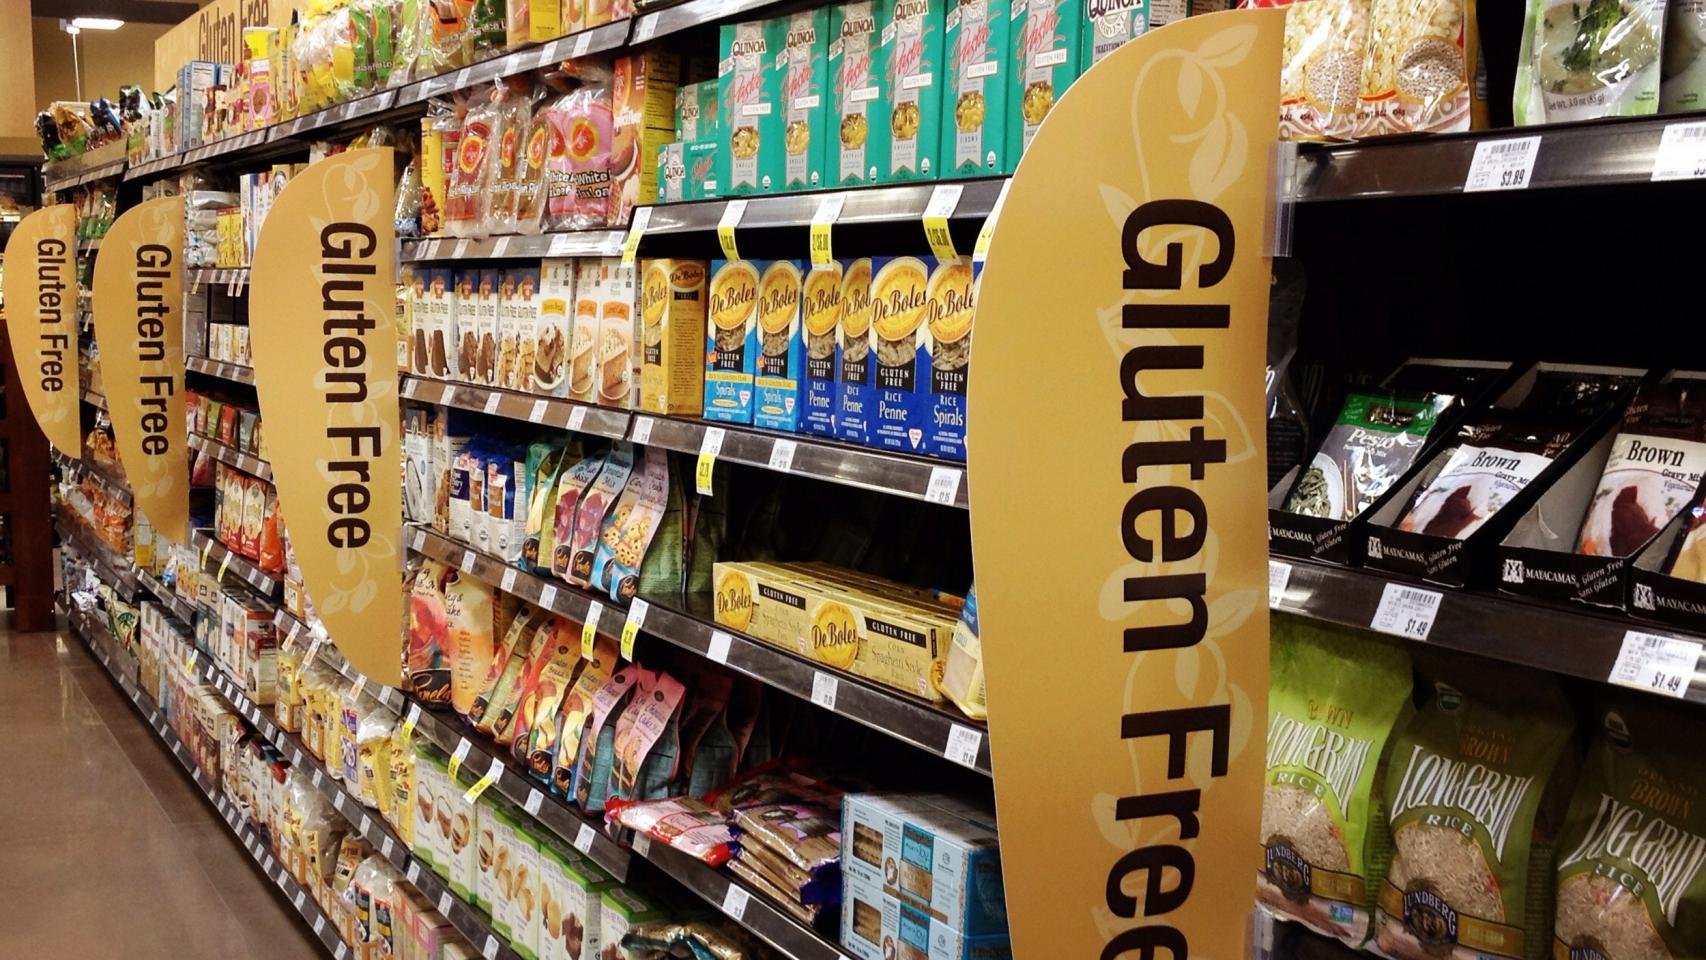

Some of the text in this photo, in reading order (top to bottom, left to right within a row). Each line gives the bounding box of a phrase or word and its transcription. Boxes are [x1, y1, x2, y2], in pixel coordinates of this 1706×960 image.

[896, 1, 928, 20] QUINOA
[199, 6, 235, 64] Gluten
[843, 19, 874, 36] QUINOA
[788, 30, 815, 48] QUINOA
[733, 41, 765, 56] QUINOA
[1500, 168, 1525, 187] $3.89
[37, 239, 68, 392] Gluten Free
[136, 244, 174, 456] Gluten Free
[718, 353, 740, 361] GLUTEN
[764, 358, 785, 366] GLUTEN
[767, 366, 780, 374] FREE
[809, 361, 831, 369] GLUTEN
[844, 363, 864, 373] GLUTEN
[812, 368, 826, 377] FREE
[847, 372, 860, 381] FREE
[880, 368, 909, 379] GLUTEN
[935, 371, 964, 381] GLUTEN
[320, 222, 381, 549] Gluten Free
[812, 381, 826, 390] RICE
[885, 377, 903, 387] FREE
[940, 381, 957, 391] FREE
[808, 390, 830, 408] Penne
[843, 394, 863, 414] Penne
[885, 391, 902, 402] RICE
[939, 395, 957, 406] RICE
[879, 401, 908, 421] Penne
[933, 404, 964, 427] Spirals
[1347, 428, 1395, 448] Pesto
[1471, 451, 1521, 471] Brown
[1626, 440, 1685, 467] Brown
[1661, 468, 1687, 481] Gravy
[1272, 527, 1313, 543] MAYACAMAS
[1383, 546, 1426, 563] MAYACAMAS
[1099, 198, 1235, 960] Gluten Free
[1525, 568, 1577, 584] MAYACAMAS
[1581, 559, 1624, 585] Gluten Free
[1593, 574, 1618, 593] Gluten
[763, 587, 799, 606] GLUTEN FREE
[1656, 596, 1706, 615] MAYACAM
[872, 621, 916, 643] GLUTEN FREE
[1405, 618, 1428, 636] $1.49
[1652, 671, 1682, 692] $1.49
[1277, 772, 1324, 795] RICE
[1426, 813, 1473, 836] RICE
[1267, 845, 1310, 886] LUNDBERG
[1404, 889, 1456, 937] LUNDBERG
